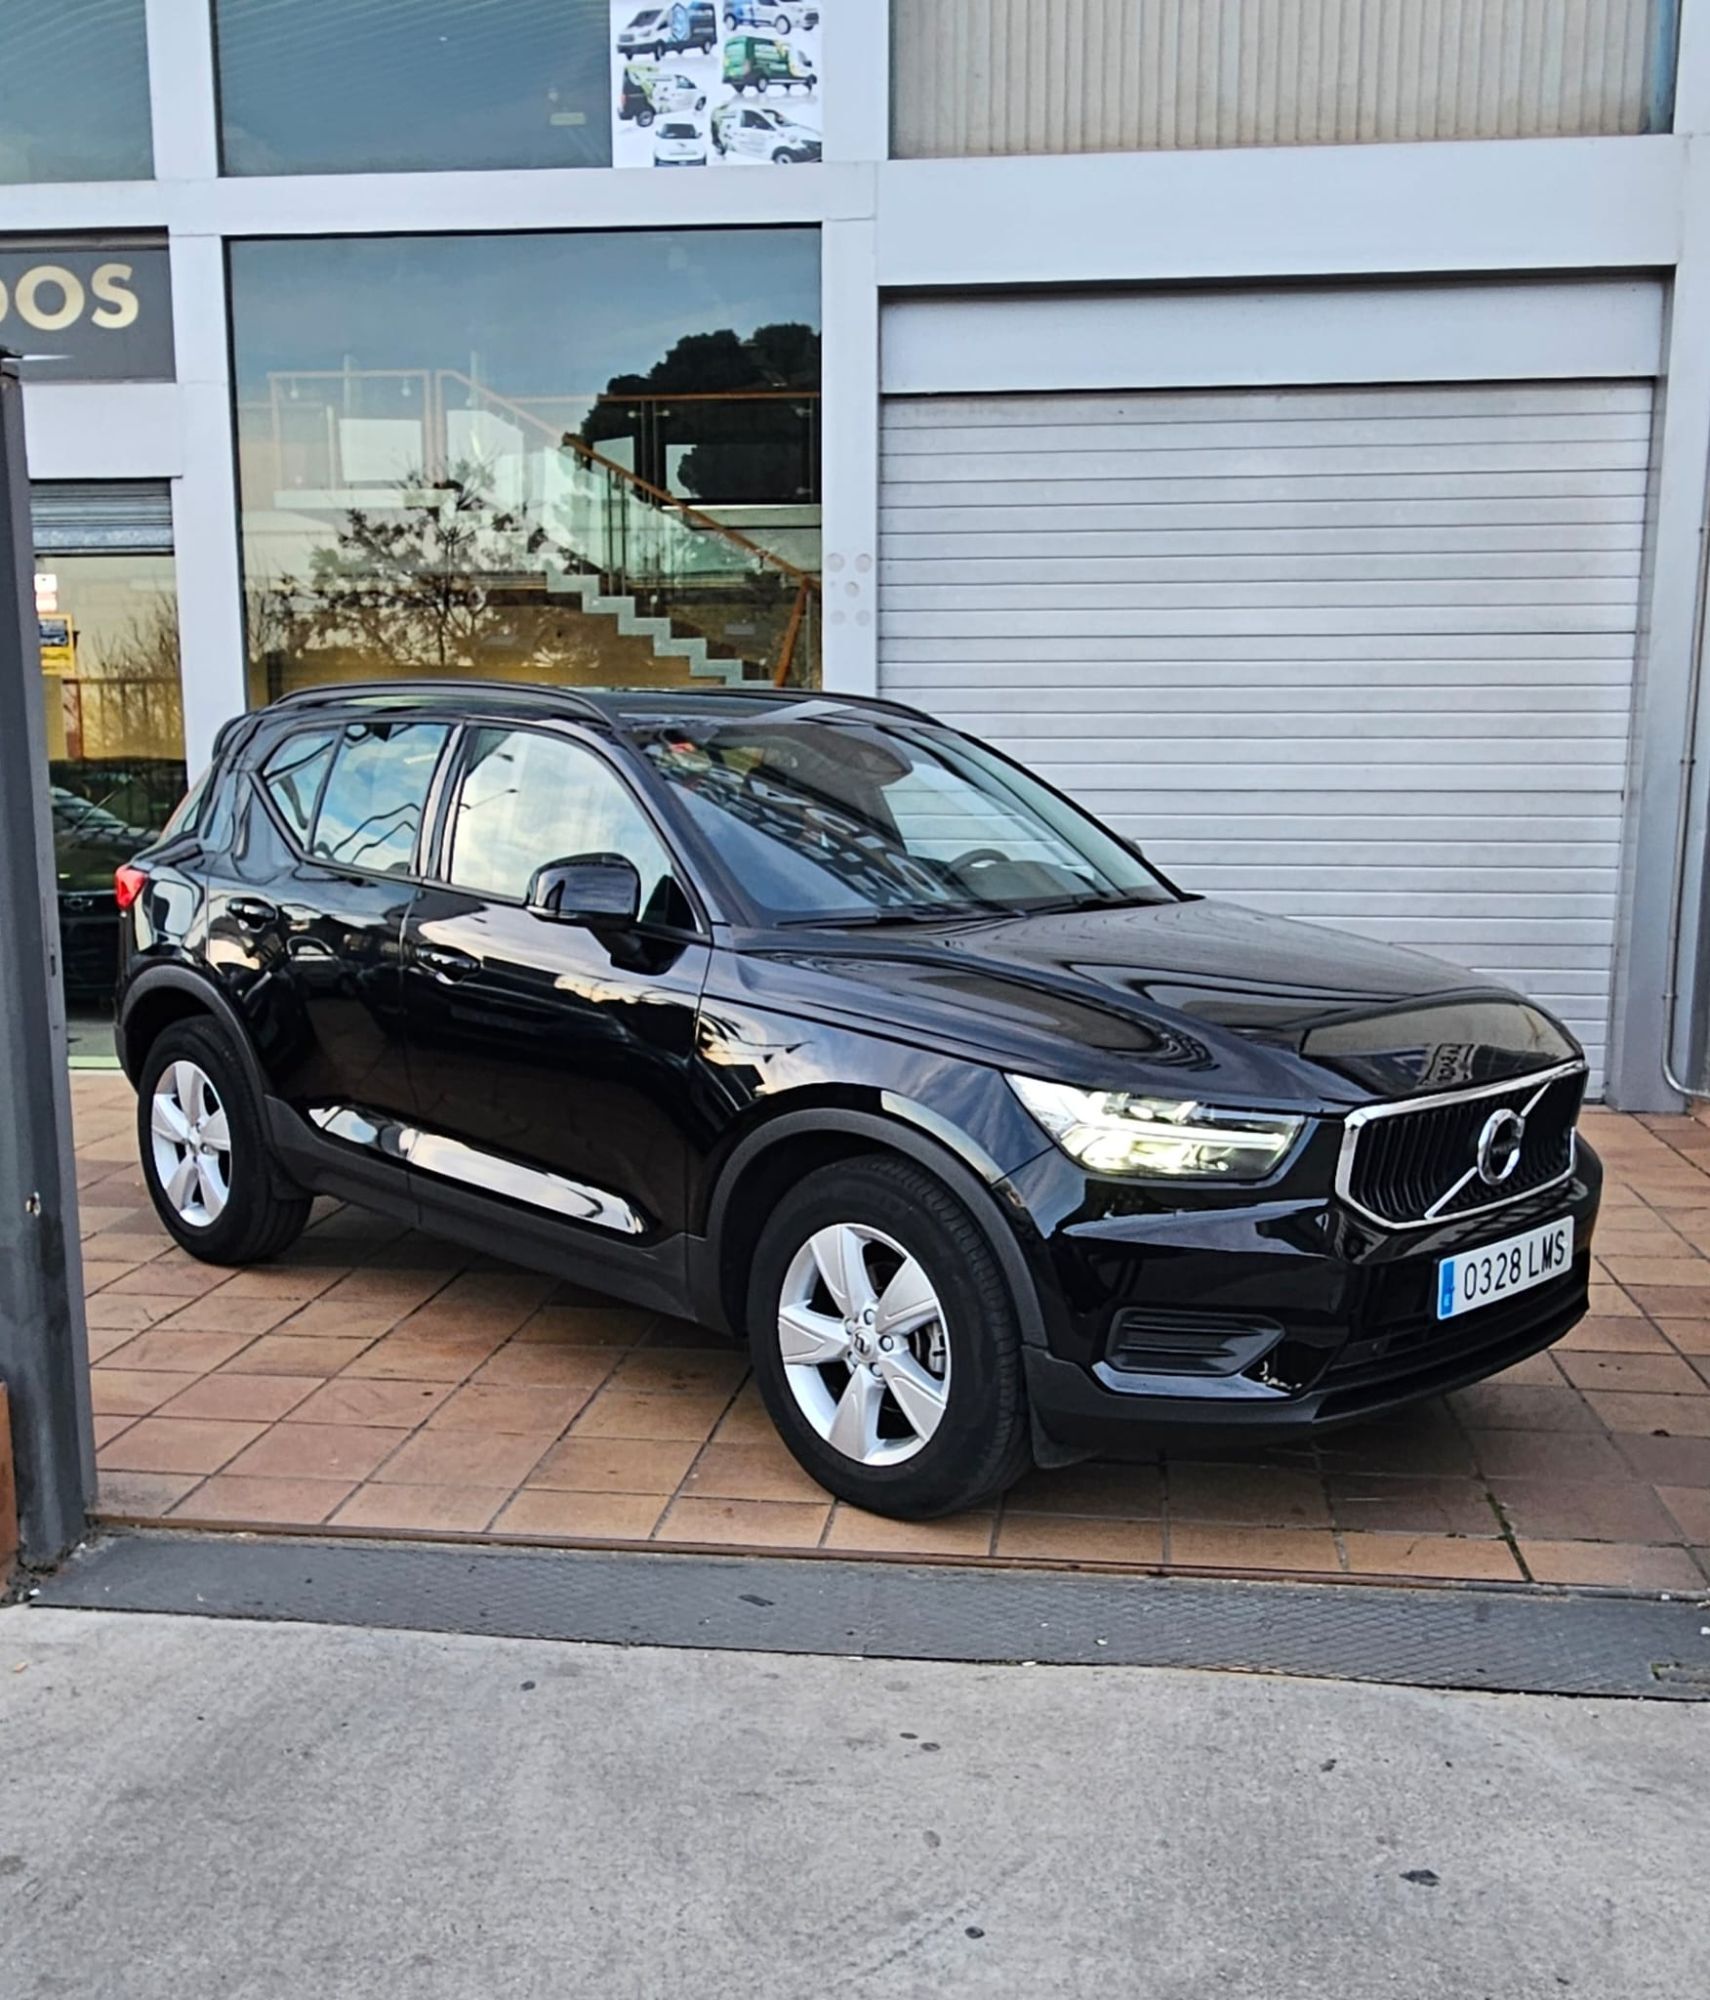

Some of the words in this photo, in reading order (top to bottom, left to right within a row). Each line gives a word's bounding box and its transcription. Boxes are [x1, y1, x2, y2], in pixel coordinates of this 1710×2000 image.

[0, 263, 139, 331] OS
[1464, 1247, 1521, 1300] 0328
[1528, 1230, 1565, 1278] LMS
